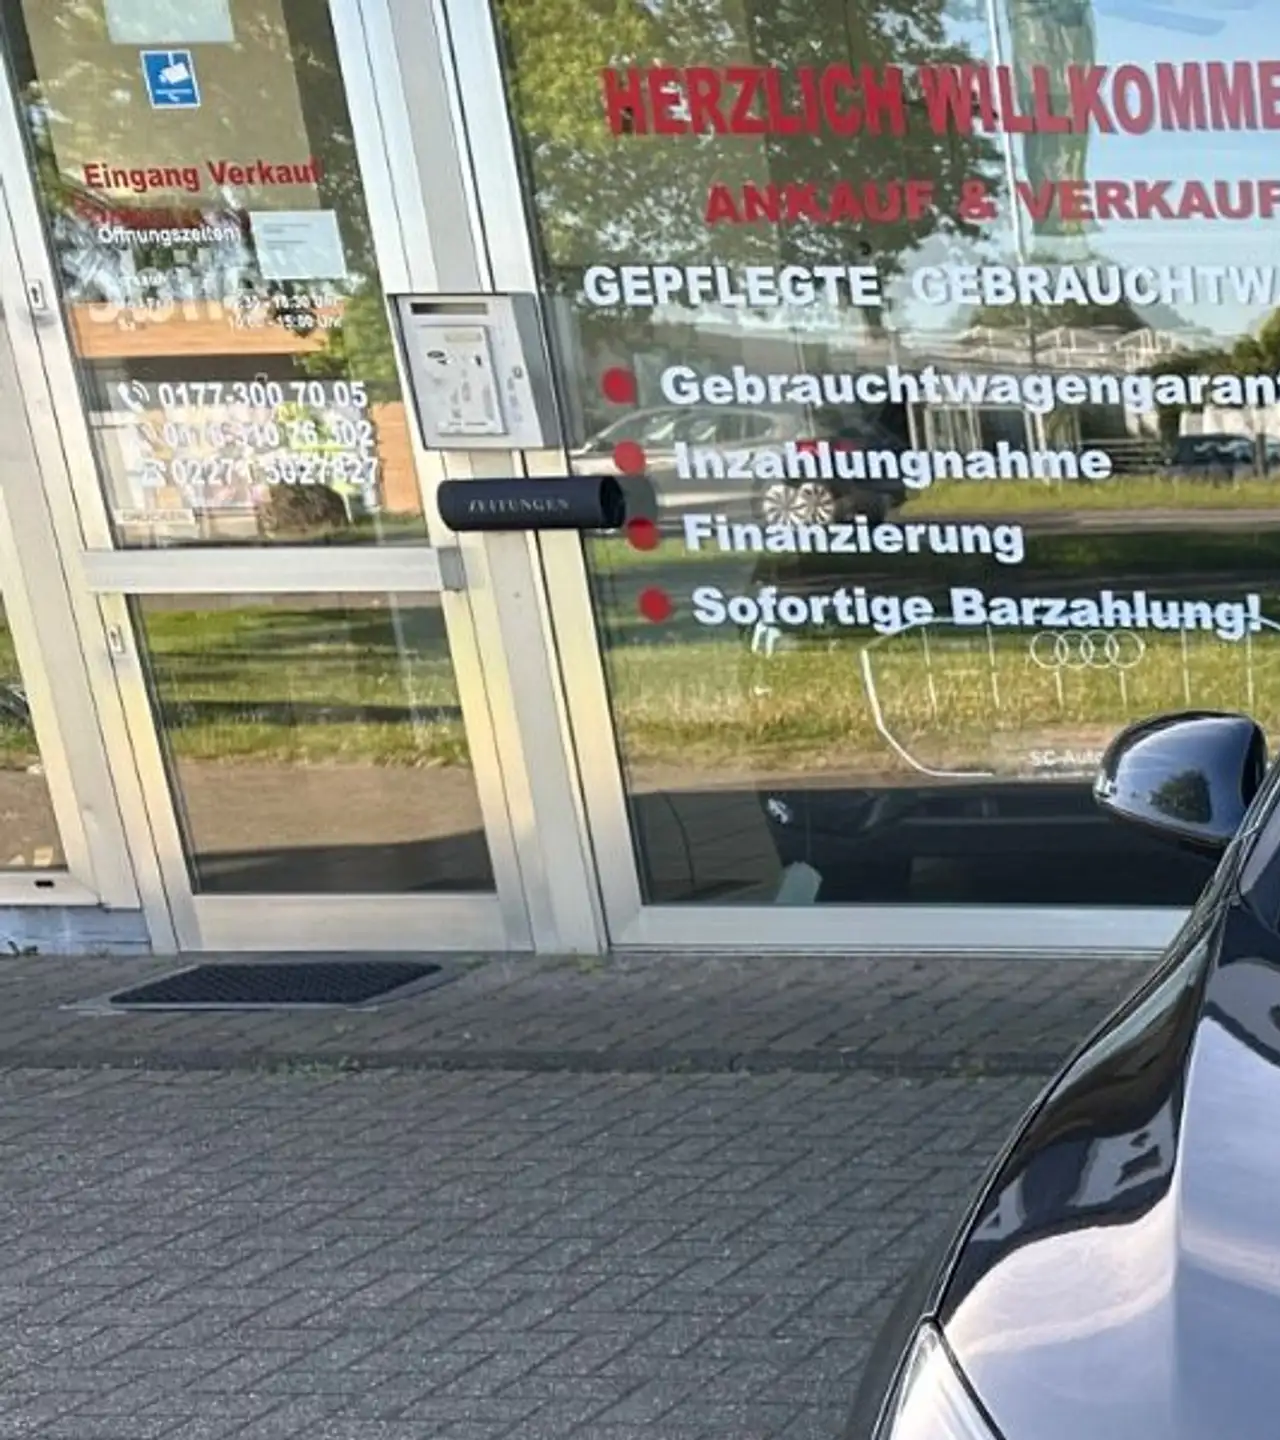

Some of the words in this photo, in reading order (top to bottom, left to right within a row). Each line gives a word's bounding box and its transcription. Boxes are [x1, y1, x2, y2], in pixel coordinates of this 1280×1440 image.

[604, 63, 904, 134] HERZLICH
[83, 162, 200, 192] Eingang
[206, 155, 325, 187] Verkauf
[705, 181, 932, 224] ANKAUF
[958, 180, 998, 222] &
[584, 265, 881, 307] GEPFLEGTE
[158, 382, 284, 409] 0177-300
[289, 381, 325, 407] 70
[333, 381, 369, 407] 05
[675, 441, 1112, 486] Inzahlungnahme
[684, 514, 1025, 565] Finanzierung
[692, 586, 934, 634] Sofortige
[951, 588, 1262, 641] Barzahlung!
